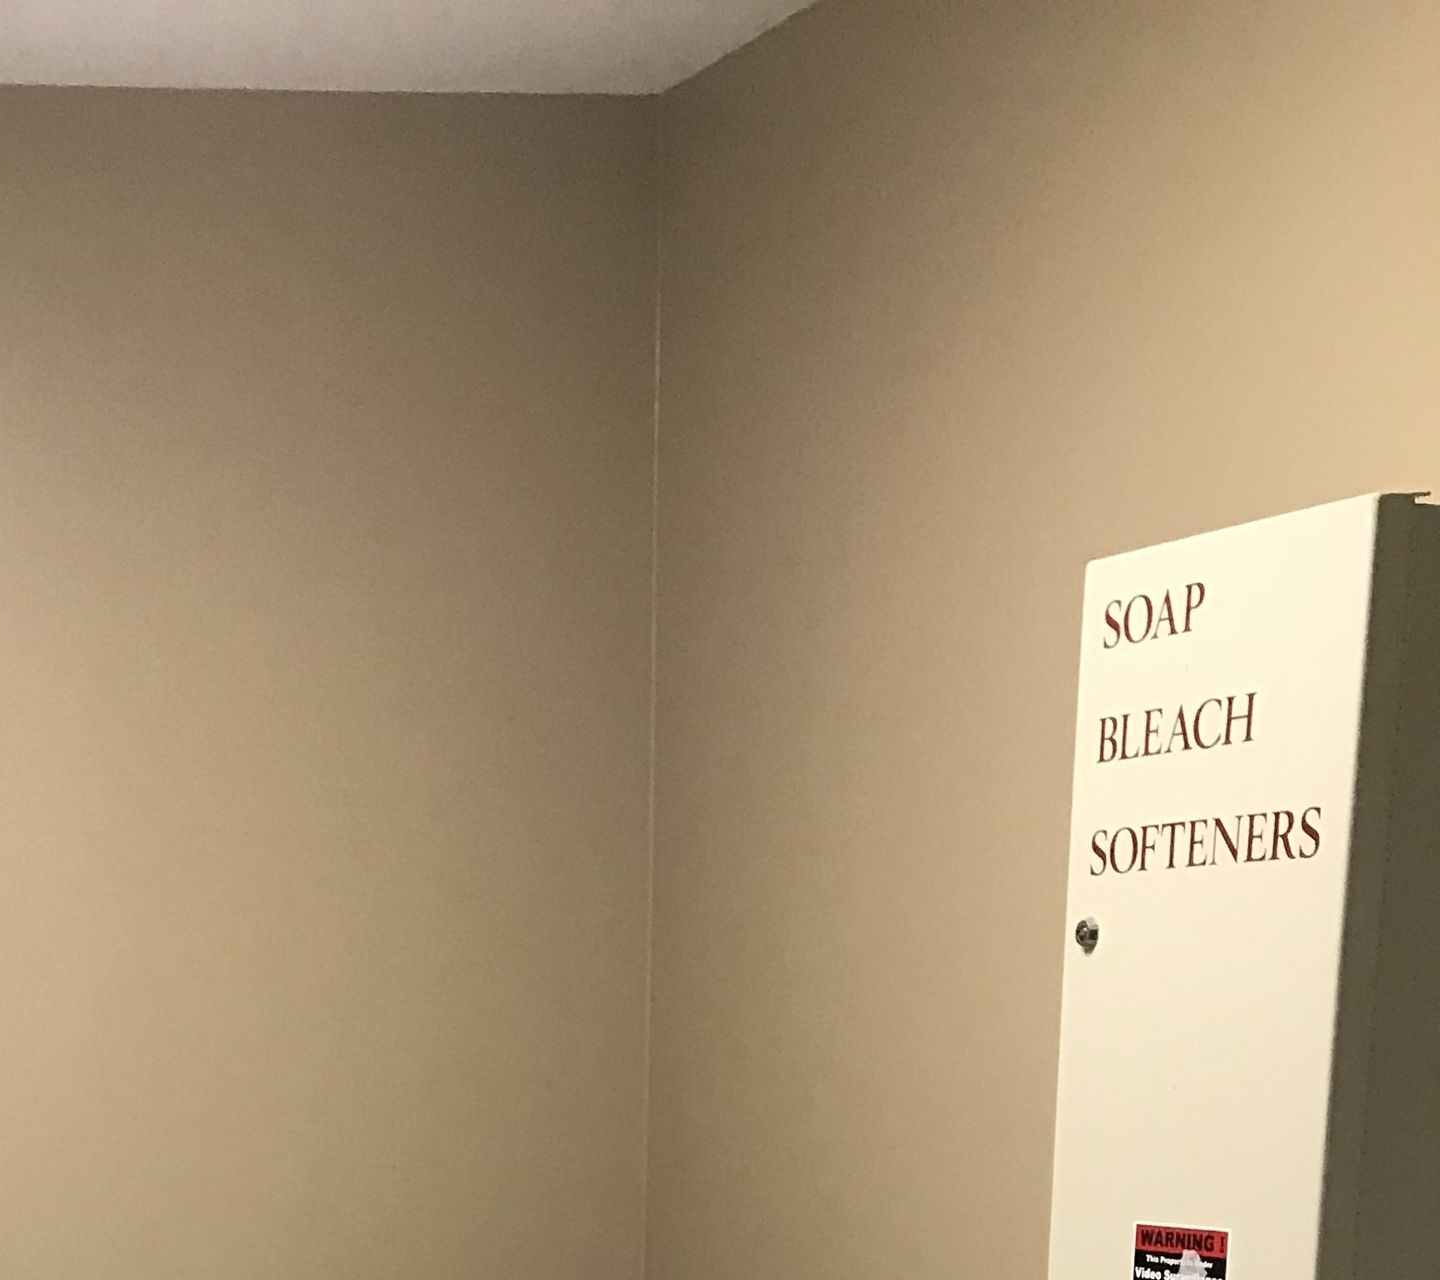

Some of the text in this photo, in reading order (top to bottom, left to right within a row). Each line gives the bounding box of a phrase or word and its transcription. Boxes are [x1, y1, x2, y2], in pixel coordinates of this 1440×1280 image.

[1103, 582, 1206, 649] SOAP
[1096, 692, 1258, 763] BLEACH
[1090, 806, 1322, 876] SOFTENERS
[1135, 1266, 1162, 1280] Video
[1140, 1229, 1215, 1252] WARNING
